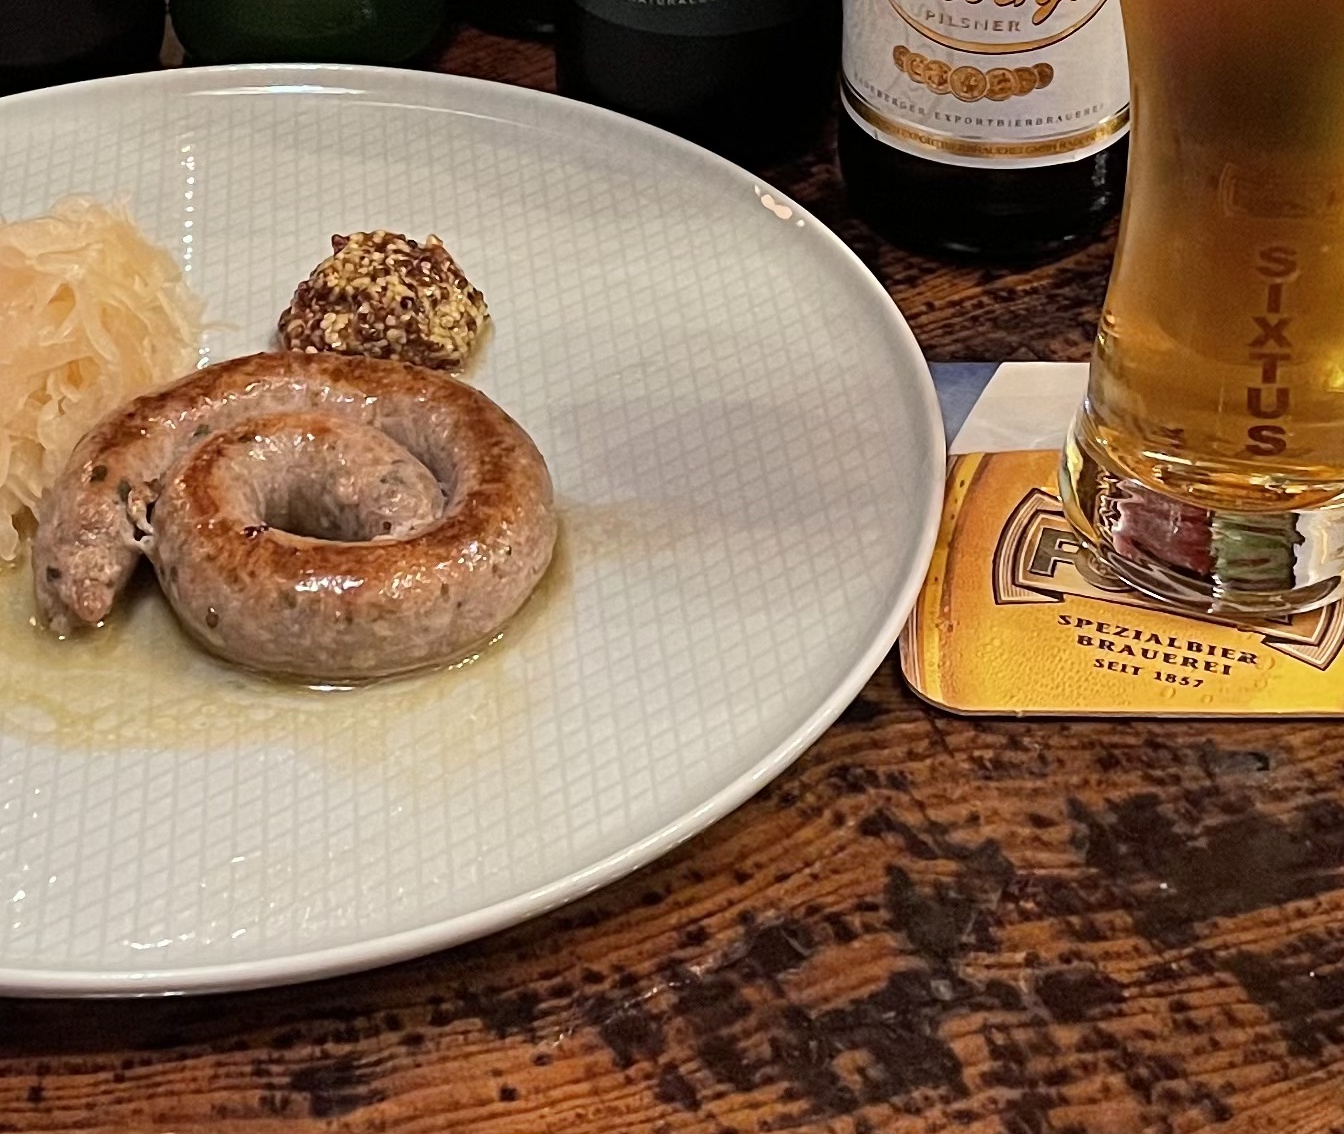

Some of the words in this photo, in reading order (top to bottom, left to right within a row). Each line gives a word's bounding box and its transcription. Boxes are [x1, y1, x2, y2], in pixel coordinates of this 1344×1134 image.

[925, 9, 1022, 33] PILSNER
[1245, 246, 1300, 456] SIXTUS
[1057, 614, 1259, 665] SPEZIALBIER
[1076, 634, 1233, 676] BRAUEREI
[1092, 658, 1144, 677] SEIT
[1152, 670, 1205, 689] 1857
